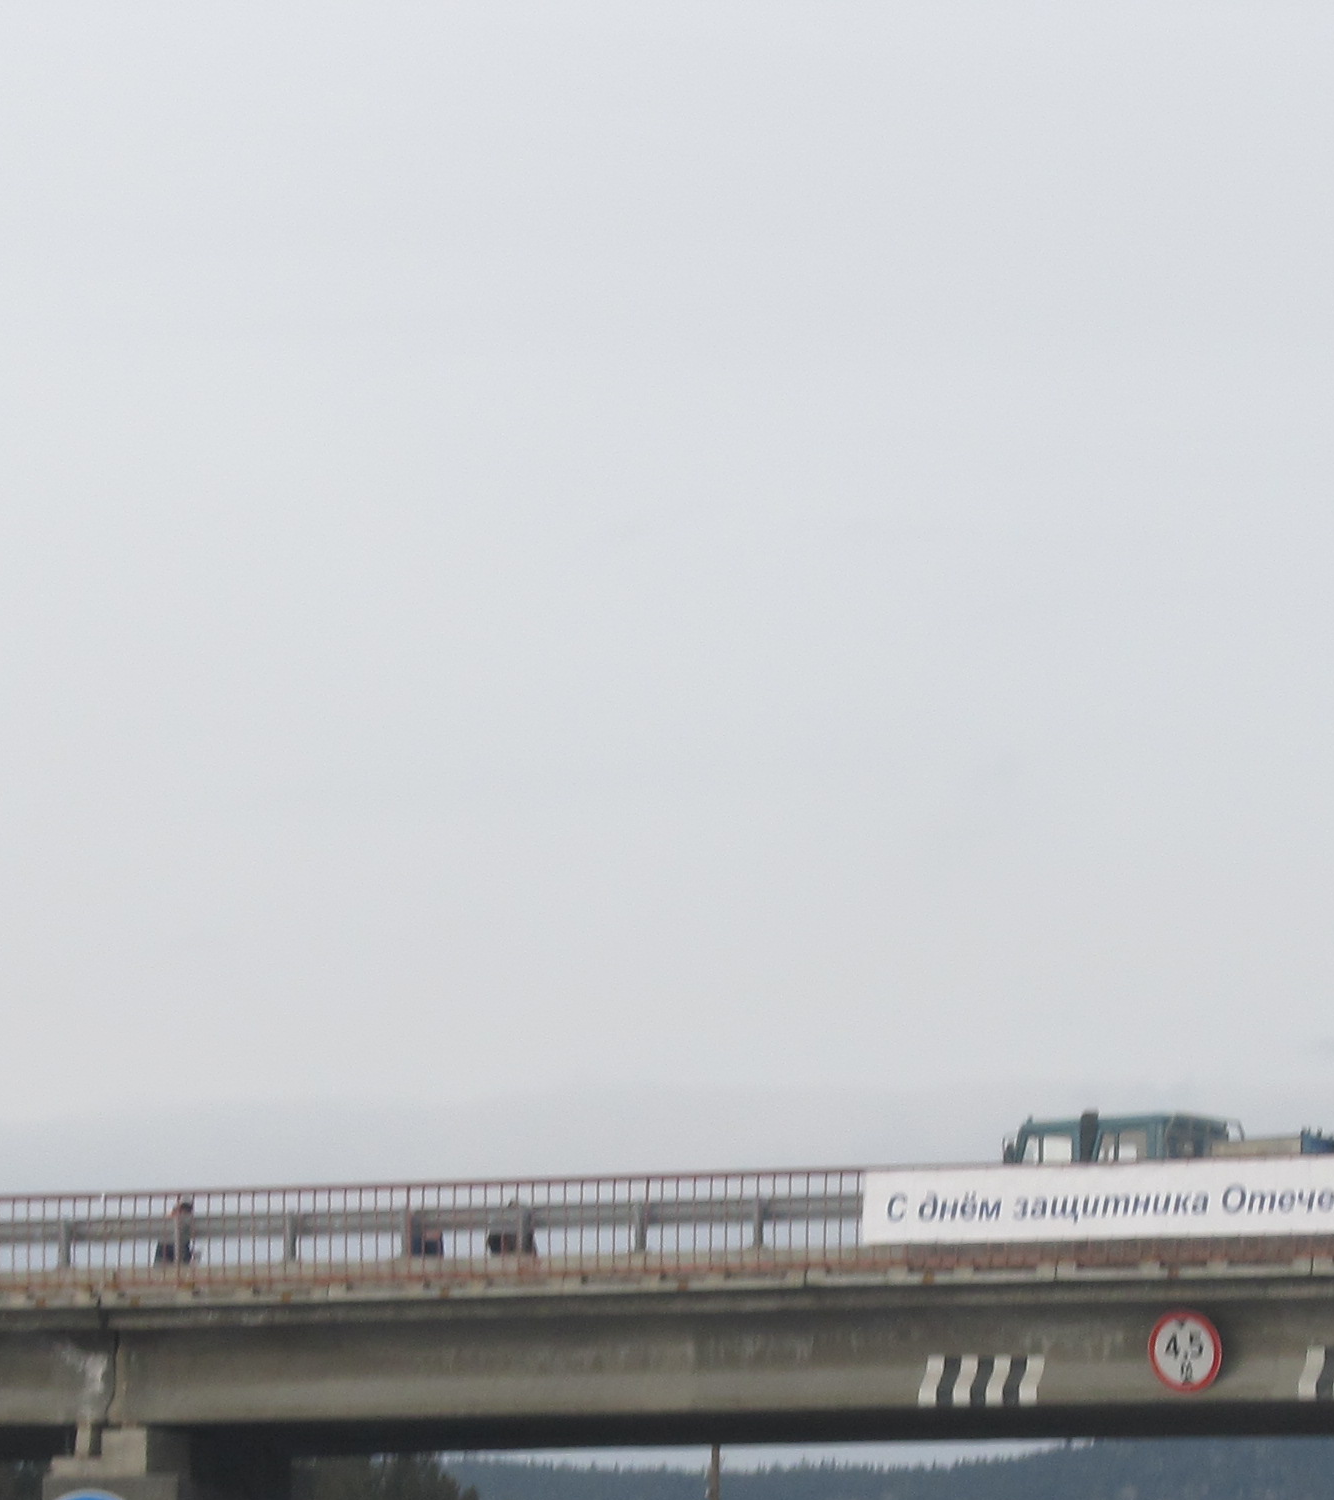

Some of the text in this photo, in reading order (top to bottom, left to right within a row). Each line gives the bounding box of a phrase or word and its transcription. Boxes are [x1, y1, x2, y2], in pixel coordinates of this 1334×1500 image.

[886, 1191, 908, 1222] С
[918, 1190, 1002, 1222] днём
[1013, 1191, 1209, 1225] защитника
